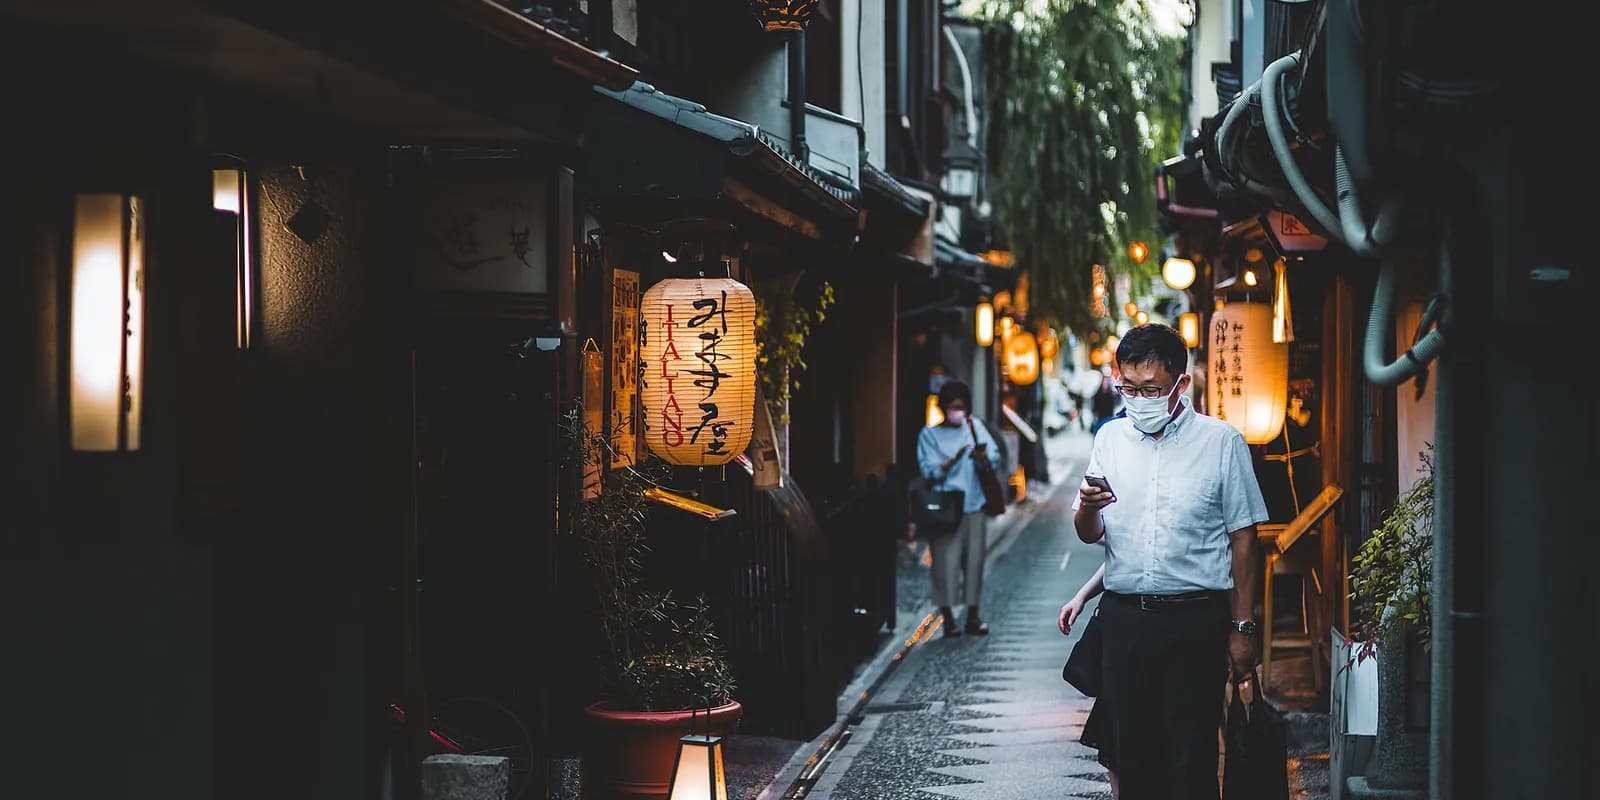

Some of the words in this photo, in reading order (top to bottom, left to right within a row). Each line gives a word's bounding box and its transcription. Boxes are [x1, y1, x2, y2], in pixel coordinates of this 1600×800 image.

[661, 304, 684, 447] ITALIANO
[680, 291, 735, 456] みます屋
